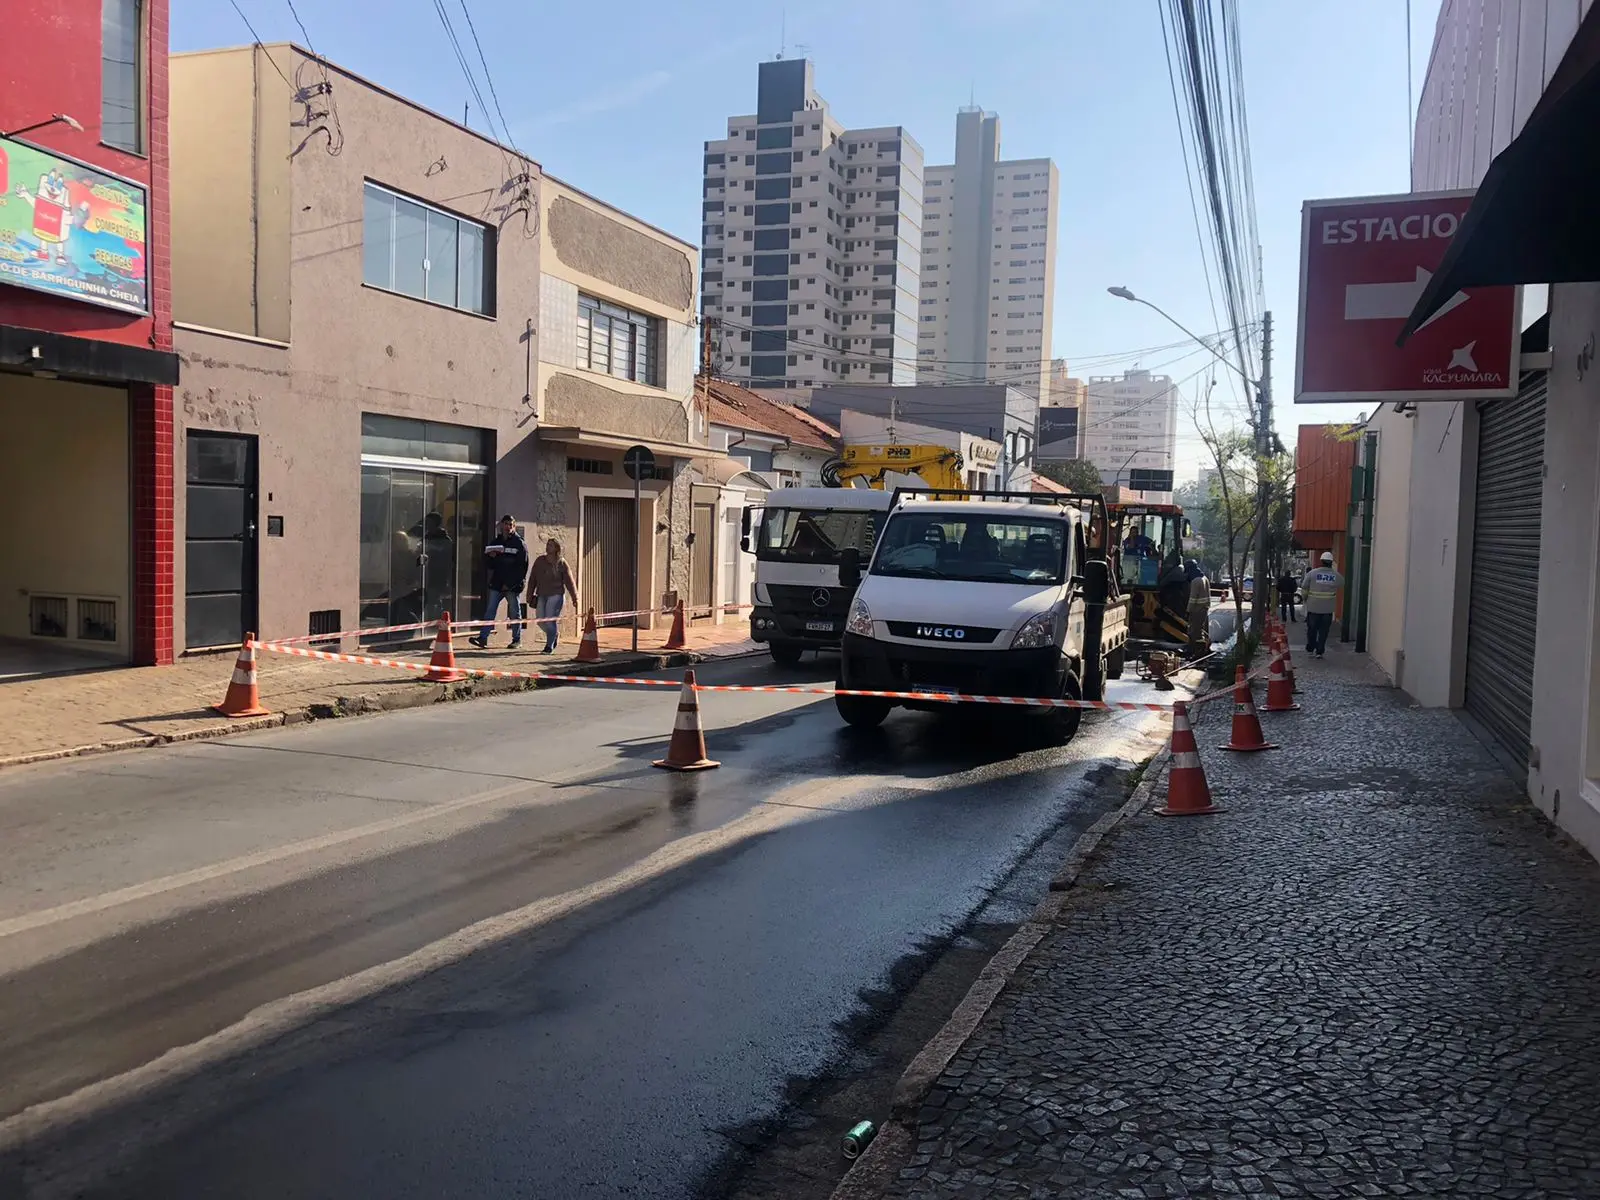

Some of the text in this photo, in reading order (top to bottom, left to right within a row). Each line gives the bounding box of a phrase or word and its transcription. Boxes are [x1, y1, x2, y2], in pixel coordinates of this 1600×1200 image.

[1322, 212, 1463, 245] ESTACIO
[109, 289, 140, 304] CHEIA
[1316, 574, 1335, 582] BRK
[916, 626, 965, 639] IVECO
